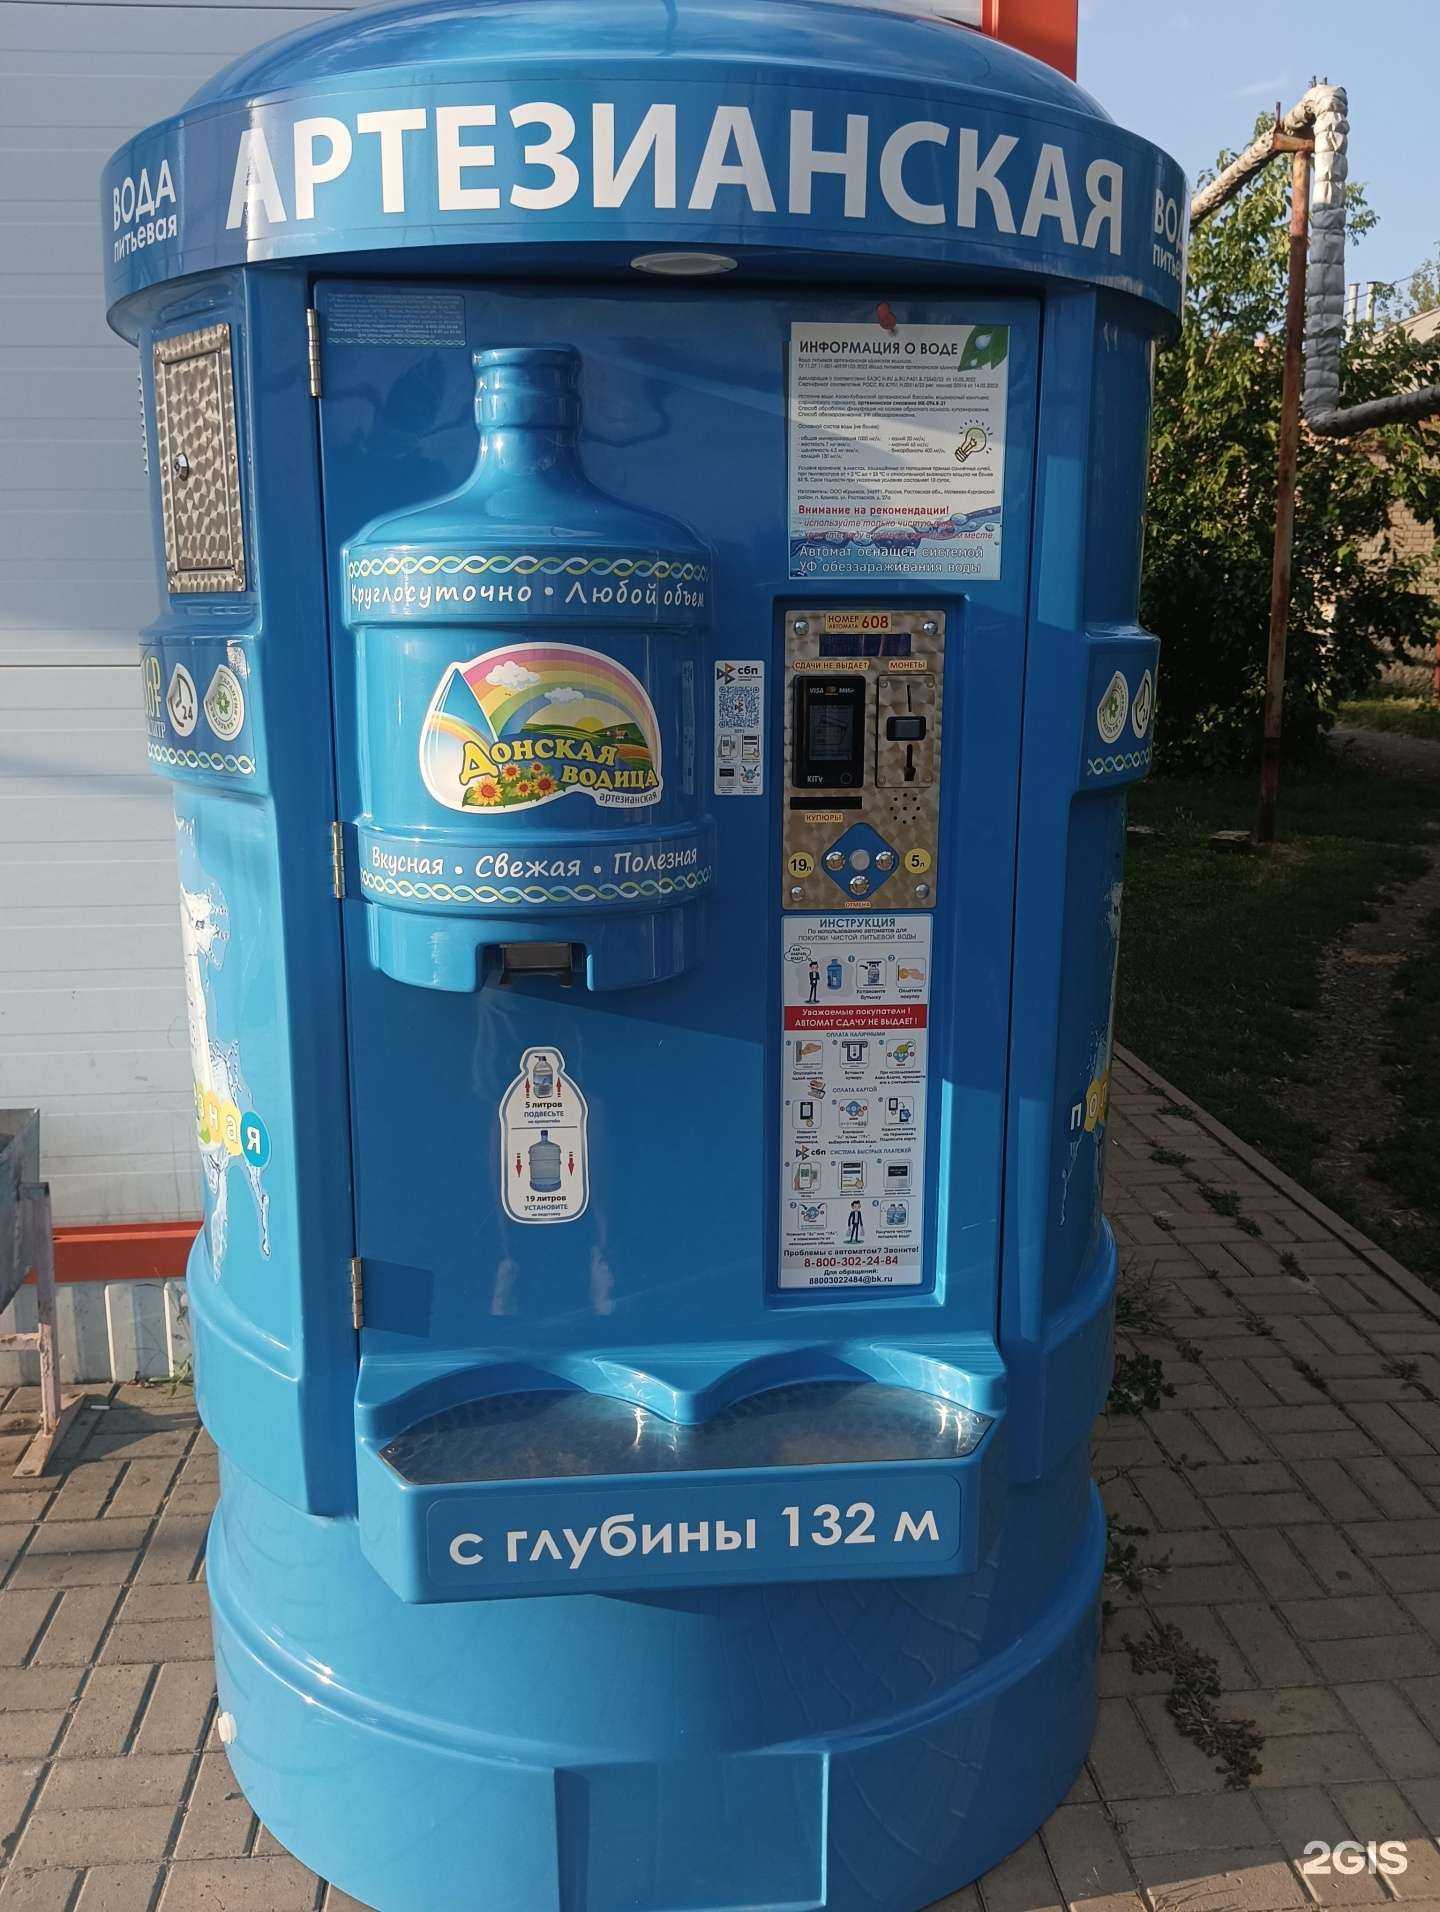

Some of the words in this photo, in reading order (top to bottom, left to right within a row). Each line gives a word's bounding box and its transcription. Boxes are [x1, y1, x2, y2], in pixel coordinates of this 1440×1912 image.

[225, 102, 1123, 255] АРТЕЗИАНСКАЯ
[113, 159, 176, 231] ВОДА
[113, 214, 176, 263] питьевая
[799, 340, 899, 355] ИНФОРМАЦИЯ
[904, 343, 915, 354] О
[920, 343, 958, 356] ВОДЕ
[798, 505, 850, 515] Внимание
[870, 505, 949, 517] рекомендации!
[804, 519, 860, 528] используйте
[799, 546, 851, 557] Автомат
[857, 547, 916, 558] оснащен
[921, 545, 983, 557] системой
[799, 562, 817, 572] УФ
[822, 561, 942, 573] обеззараживания
[948, 563, 981, 575] воды
[351, 583, 532, 610] Круглосуточно
[565, 579, 656, 605] Любой
[664, 583, 704, 608] объем
[861, 615, 888, 628] 608
[890, 661, 924, 669] МОНЕТЫ
[738, 666, 758, 676] сбп
[182, 705, 193, 720] 24
[459, 739, 619, 786] ДОНСКАЯ
[561, 764, 659, 790] ВОДИЦА
[599, 791, 658, 805] артезианская
[371, 846, 444, 875] Вкусная
[475, 853, 581, 879] Свежая
[614, 847, 697, 874] Полезная
[819, 918, 896, 928] ИНСТРУКЦИЯ
[830, 933, 858, 941] ЧИСТОЙ
[860, 933, 896, 941] ПИТЬЕВОЙ
[802, 1008, 854, 1016] Уважаемые
[856, 1008, 906, 1016] покупатели
[795, 1018, 833, 1027] АВТОМАТ
[836, 1018, 866, 1027] СДАЧУ
[881, 1017, 914, 1026] ВЫДАЕТ
[532, 1101, 562, 1109] литров
[524, 1110, 564, 1118] ПОДВЕСЬТЕ
[536, 1195, 567, 1203] литров
[524, 1203, 568, 1211] УСТАНОВИТЕ
[884, 1246, 919, 1254] Звоните!
[804, 1256, 898, 1267] 8-800-302-24-84
[839, 1268, 879, 1276] обращений:
[809, 1275, 893, 1285] 88003022484@bk.ru
[449, 1531, 484, 1565] с
[506, 1513, 757, 1569] глубины
[781, 1502, 876, 1547] 132
[893, 1510, 940, 1541] м
